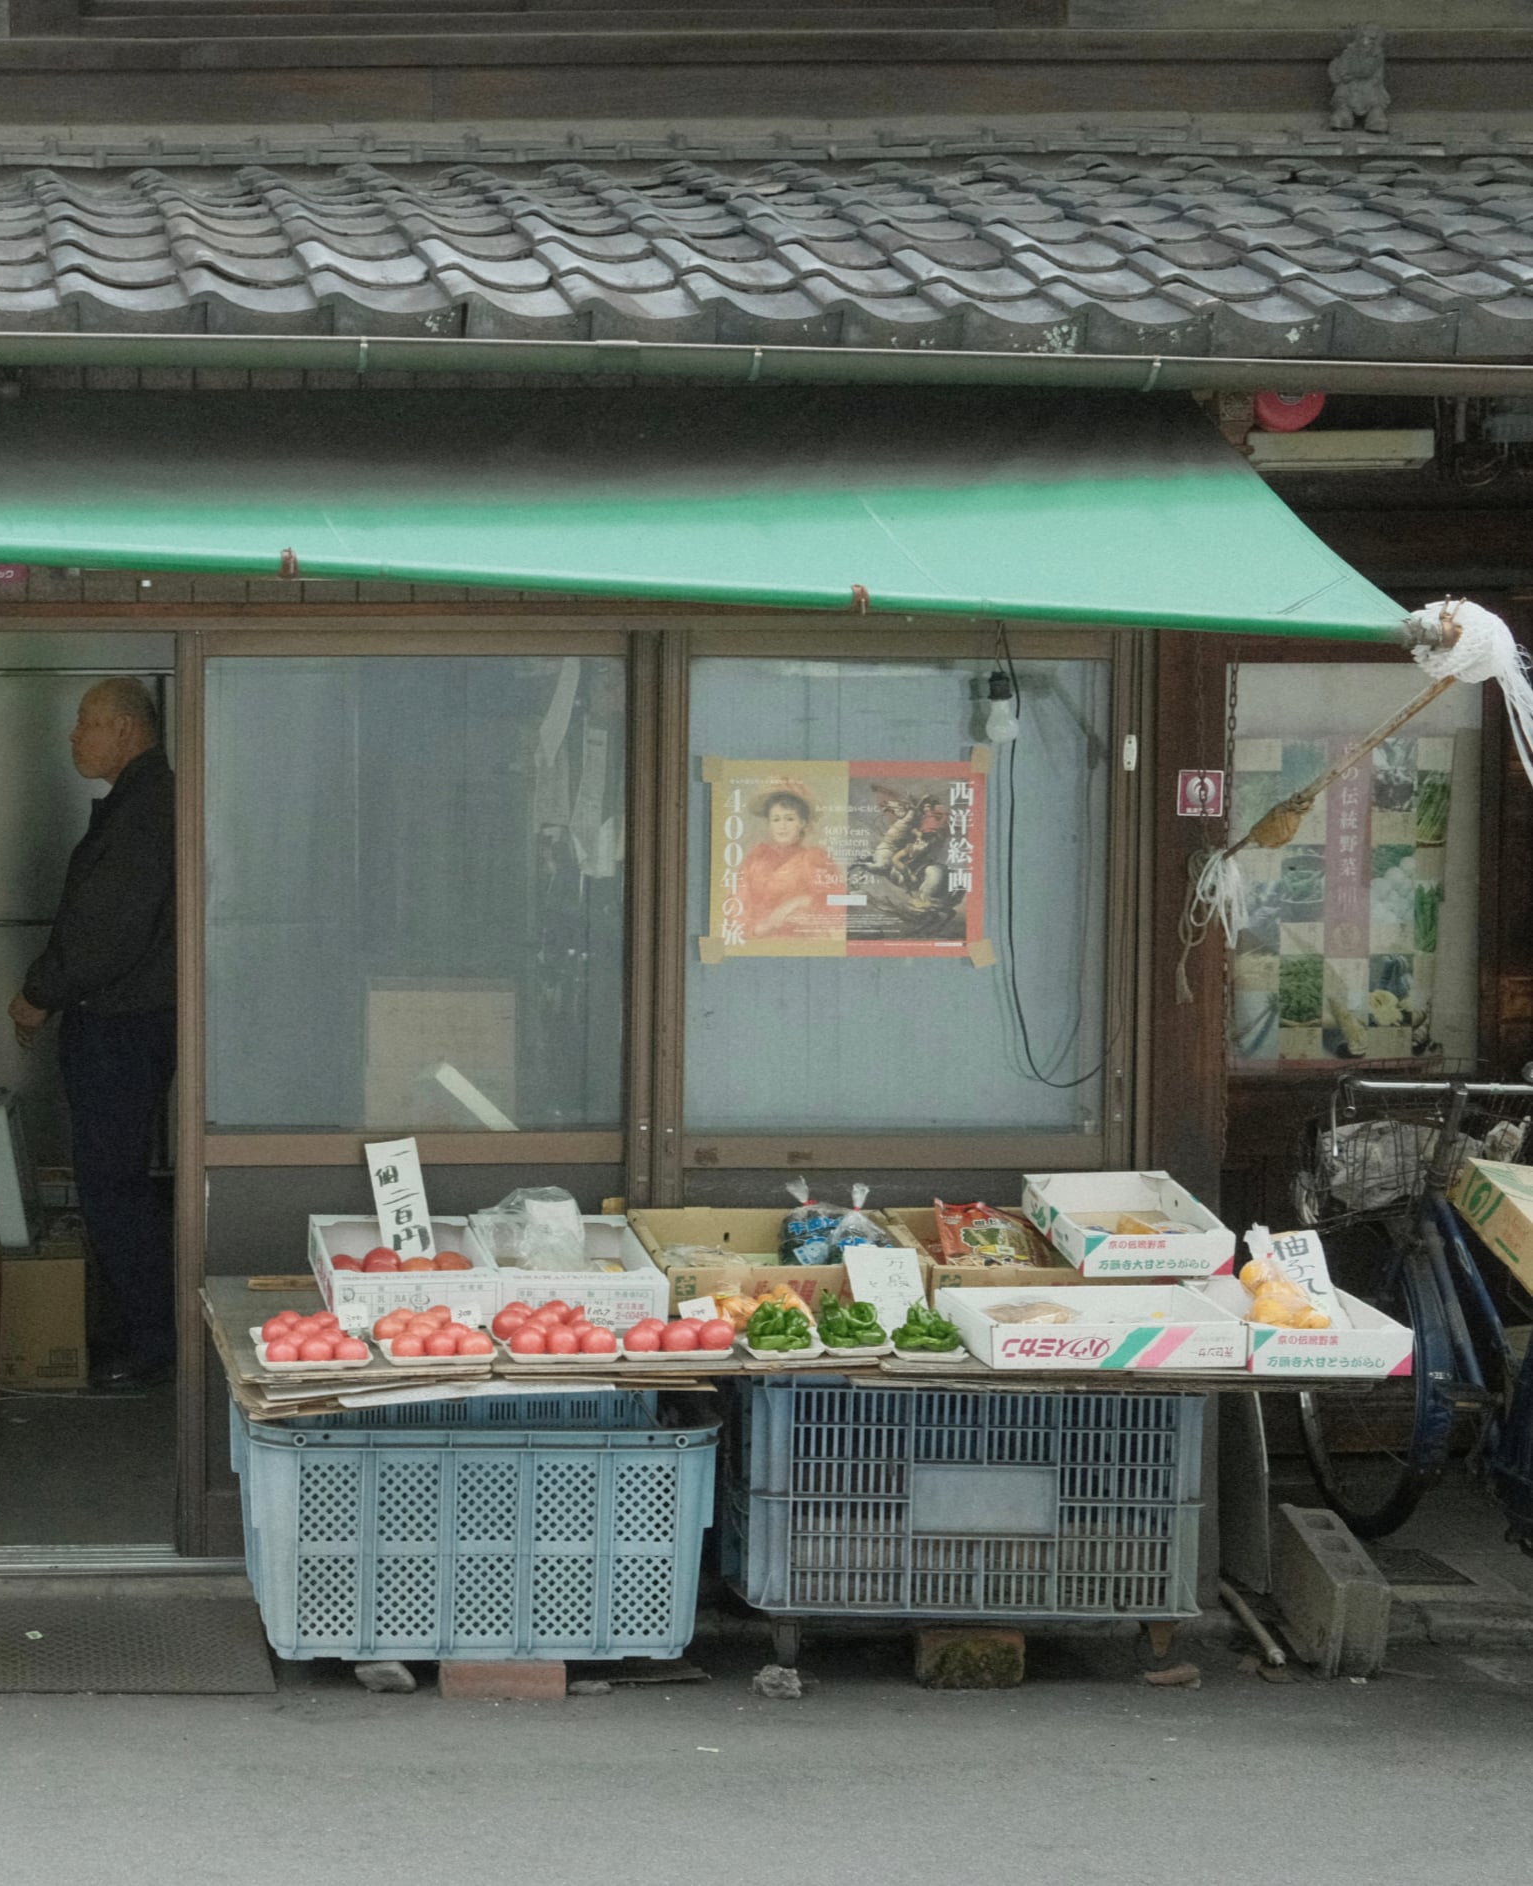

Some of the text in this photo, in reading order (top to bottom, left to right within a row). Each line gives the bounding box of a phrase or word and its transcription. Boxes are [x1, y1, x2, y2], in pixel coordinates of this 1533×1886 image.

[719, 788, 747, 947] 400年の旅
[947, 780, 975, 893] 西洋絵画
[1108, 1239, 1167, 1250] 京の伝統野菜
[1277, 1335, 1339, 1347] 京の伝統野菜
